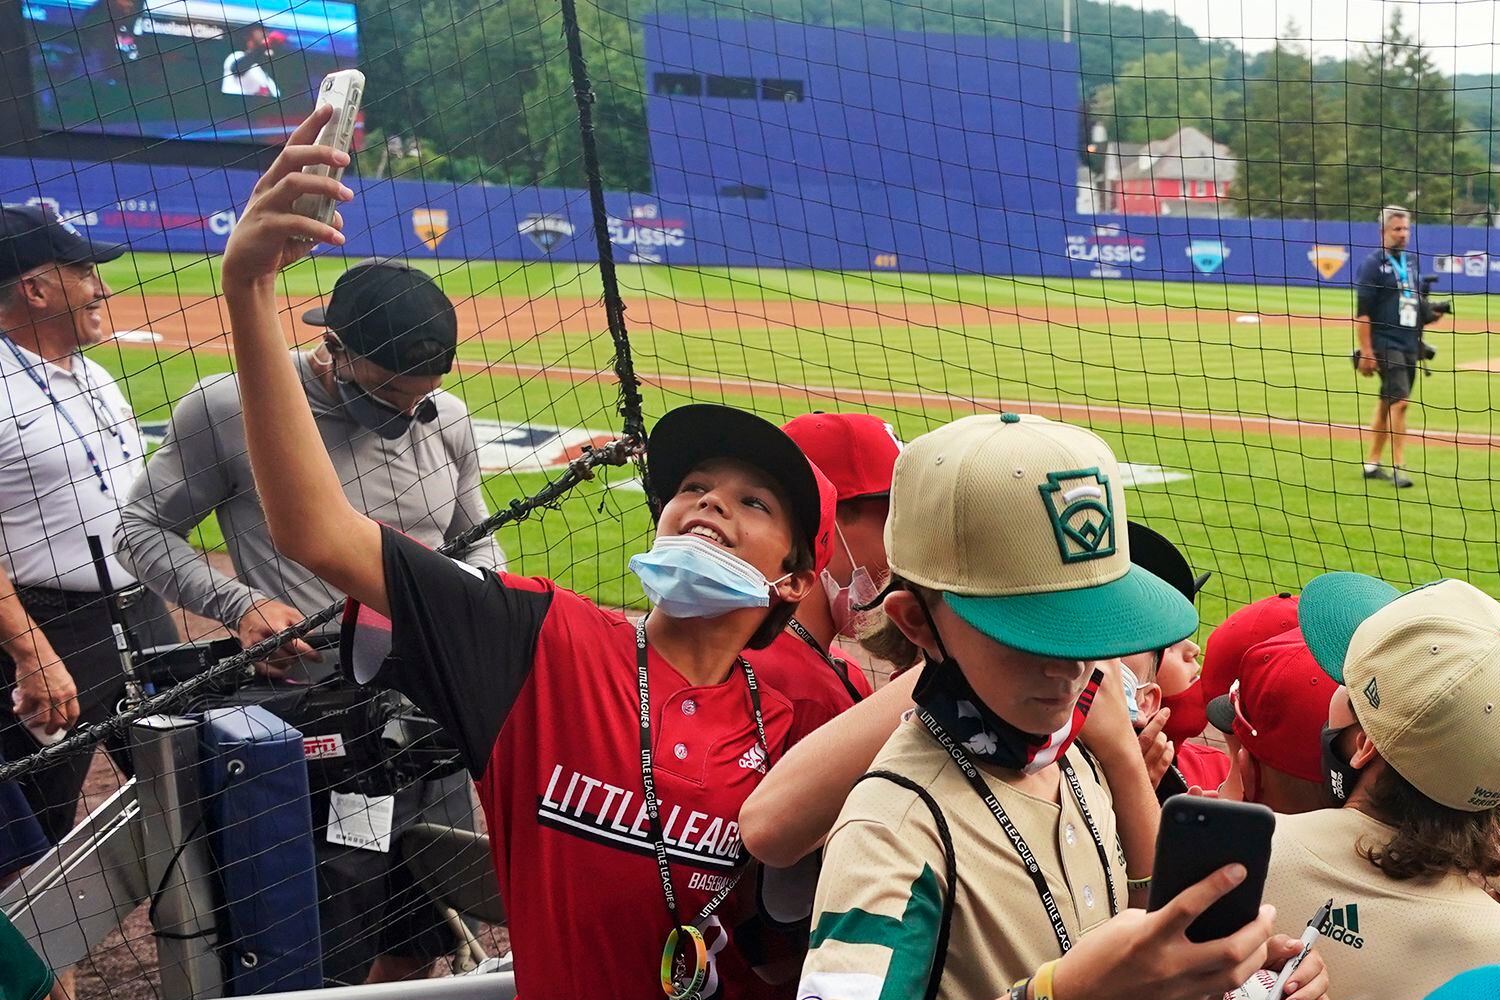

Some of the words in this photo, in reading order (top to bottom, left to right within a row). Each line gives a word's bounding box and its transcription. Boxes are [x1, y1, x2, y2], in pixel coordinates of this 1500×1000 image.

[919, 711, 943, 737] LITTLE
[541, 763, 664, 839] LITTLE
[984, 794, 1010, 826] LITTLE
[1041, 890, 1061, 922] LITTLE
[1054, 919, 1072, 951] LEAG
